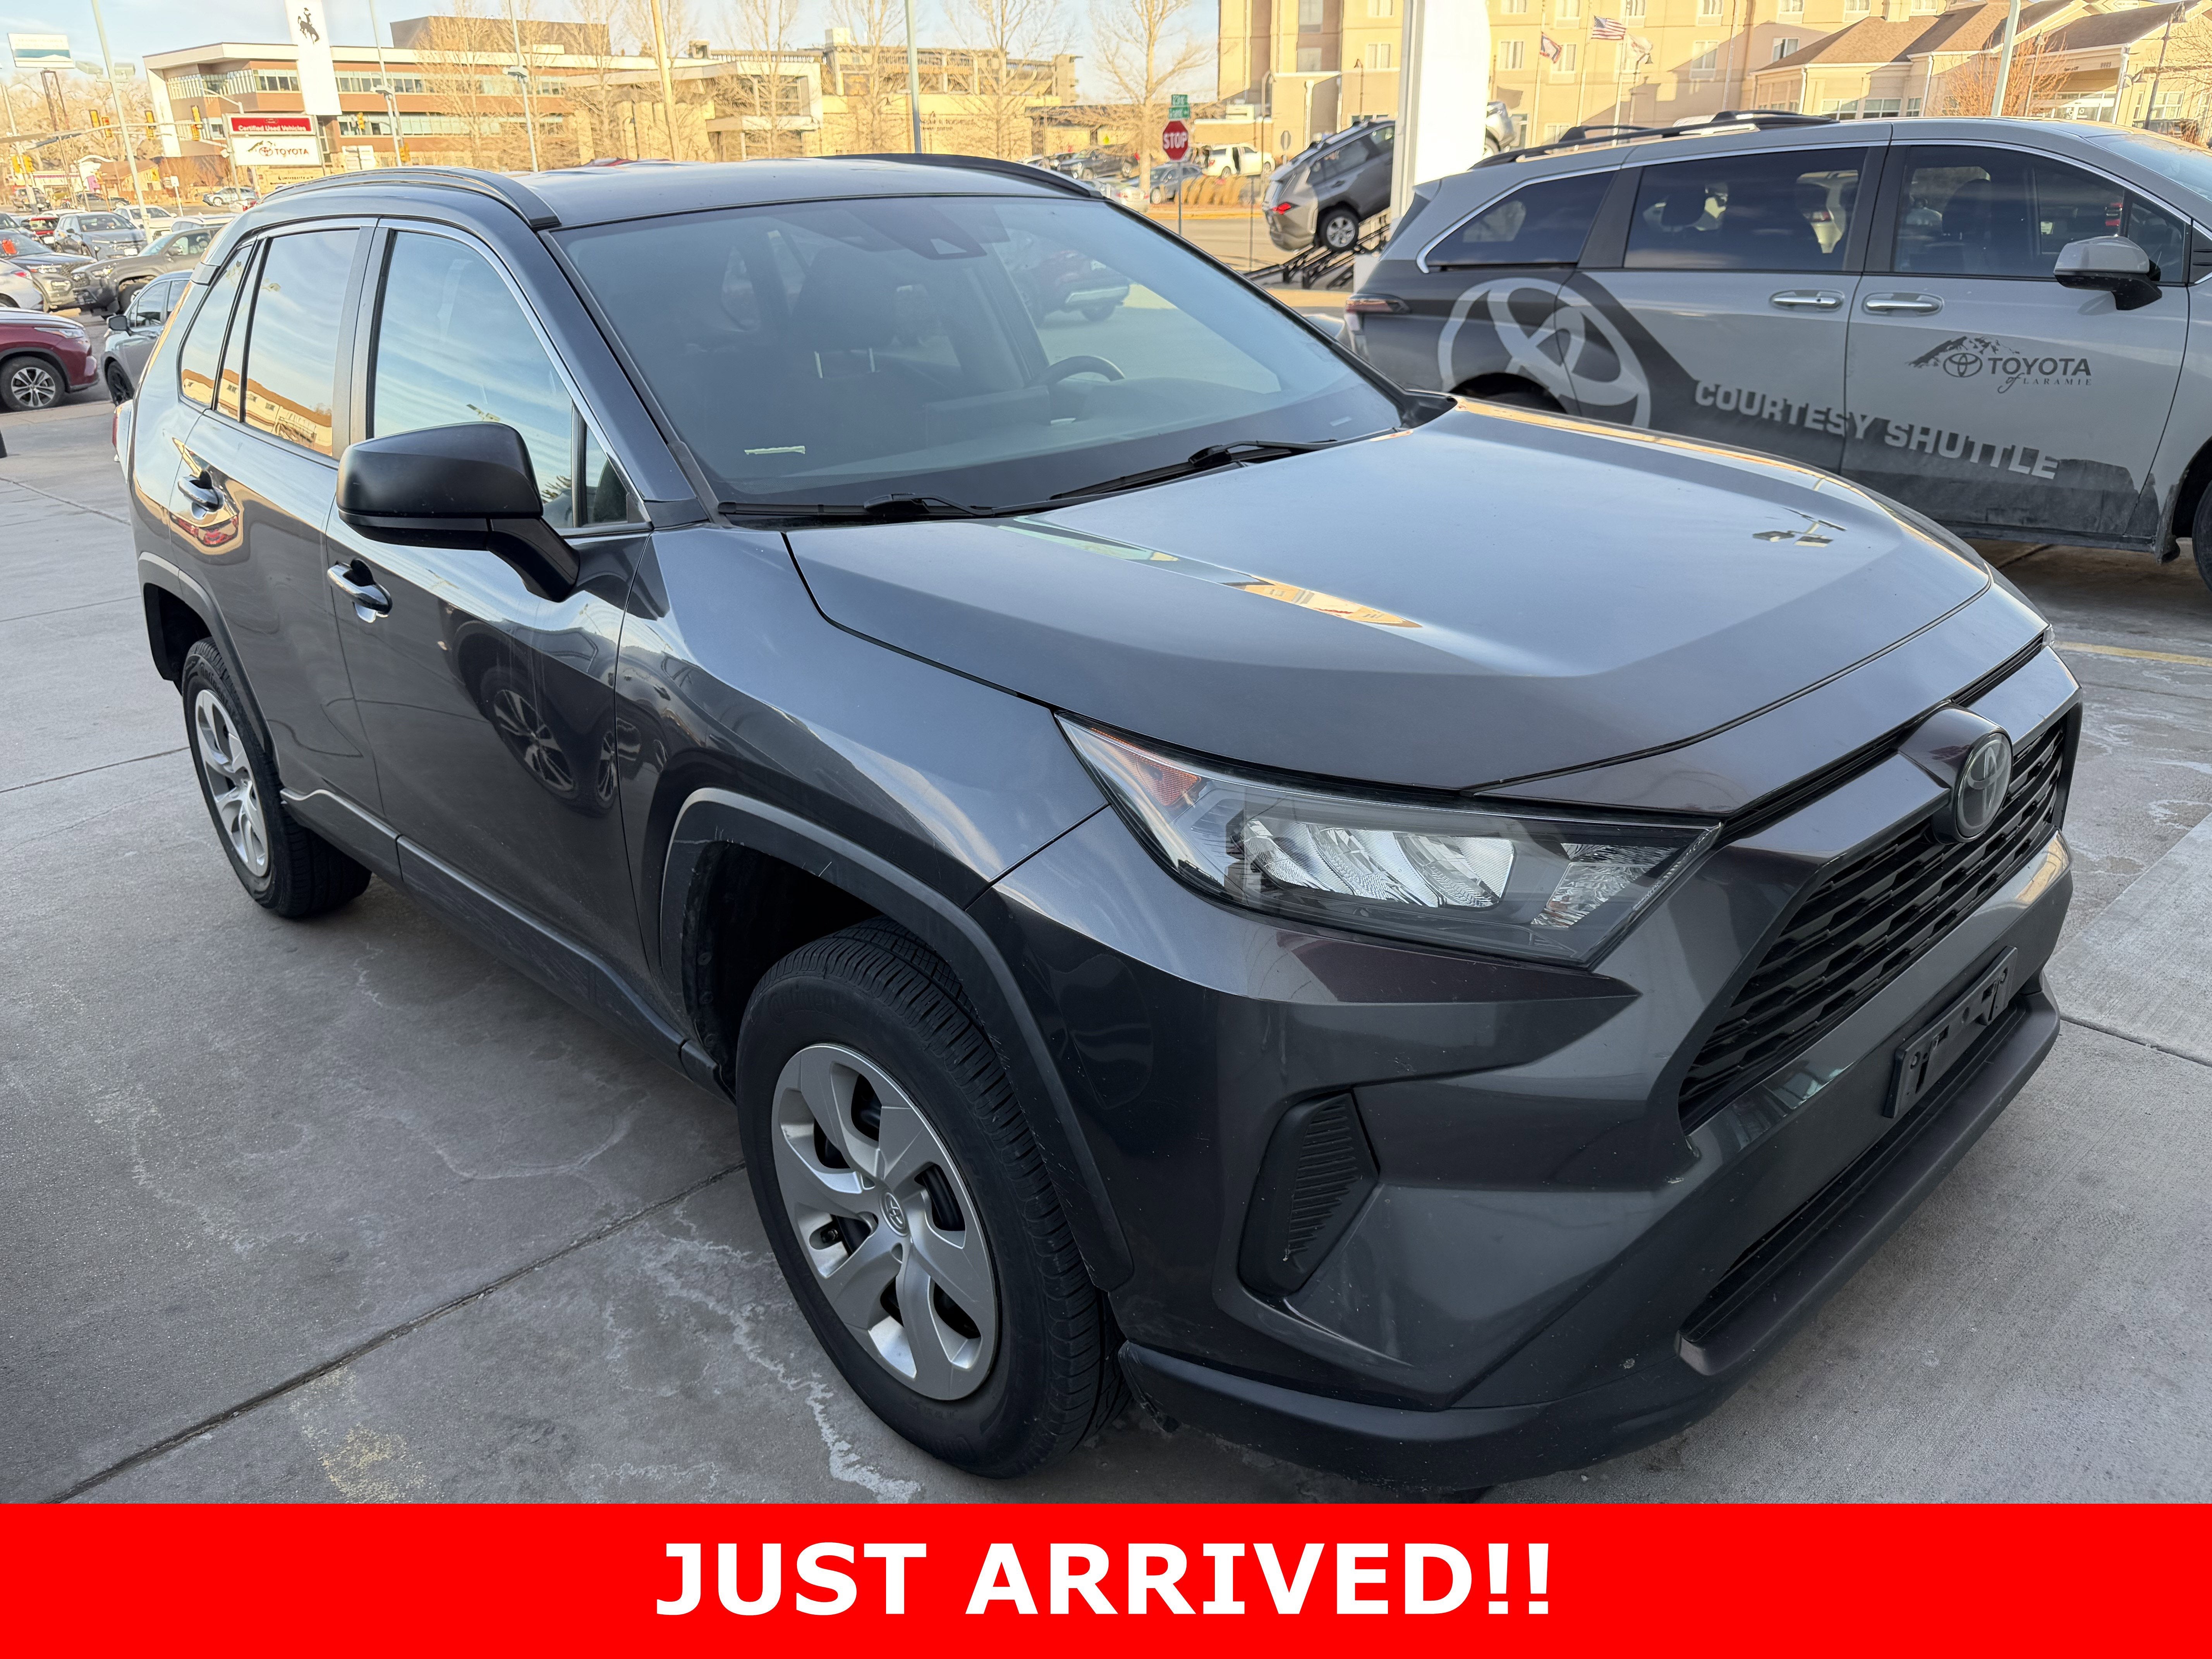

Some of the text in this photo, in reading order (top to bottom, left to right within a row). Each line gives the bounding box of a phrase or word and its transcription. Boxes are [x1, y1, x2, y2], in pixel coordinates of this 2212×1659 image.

[1163, 132, 1187, 149] STOP
[1987, 357, 2092, 376] TOYOTA
[1997, 372, 2025, 394] of
[1695, 381, 2059, 480] COURTESY SHUTTLE
